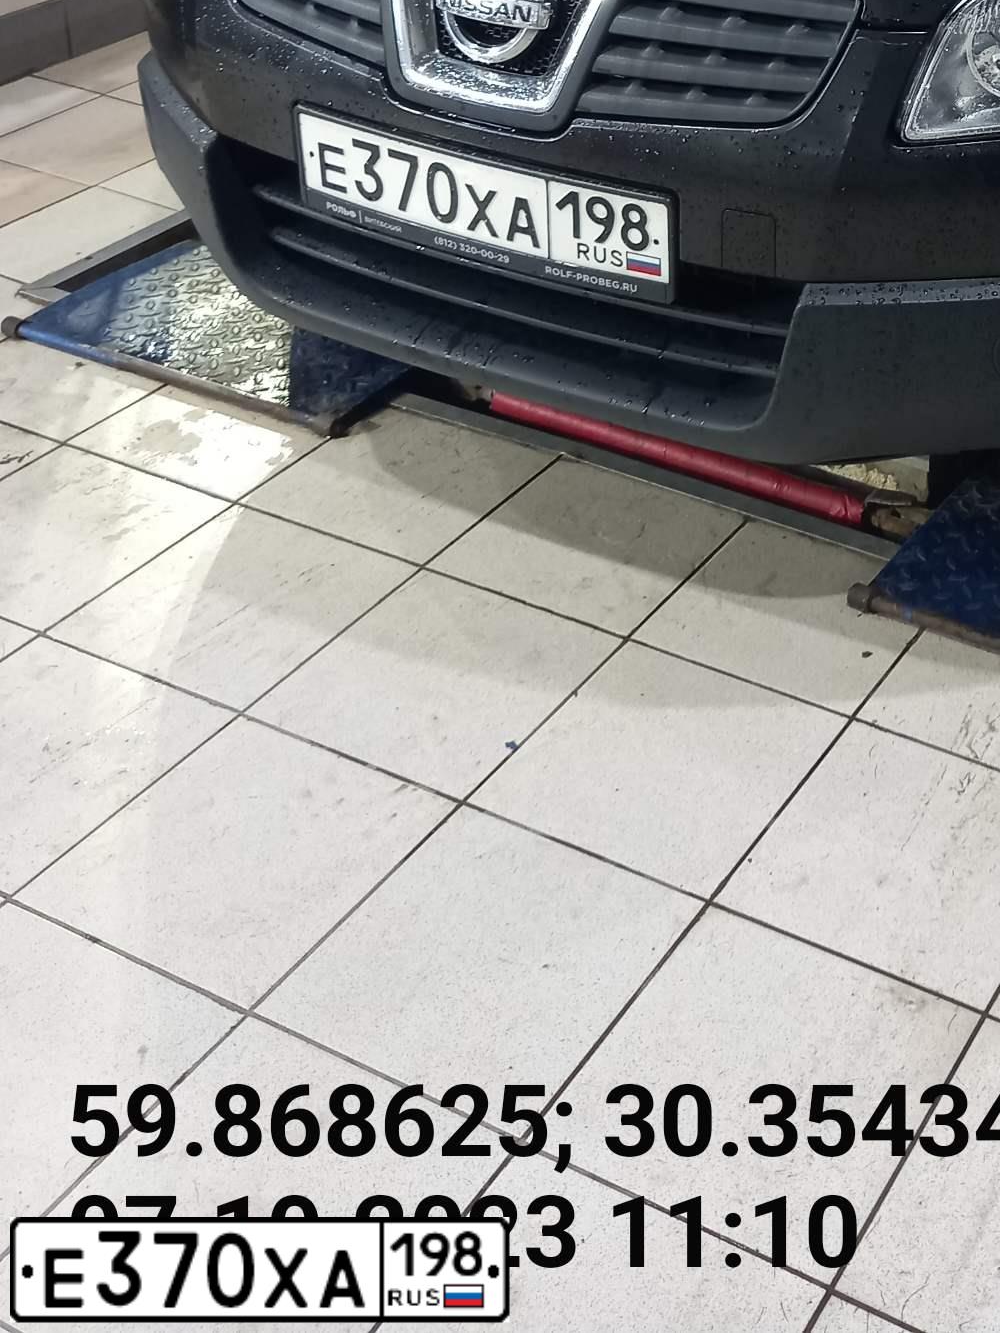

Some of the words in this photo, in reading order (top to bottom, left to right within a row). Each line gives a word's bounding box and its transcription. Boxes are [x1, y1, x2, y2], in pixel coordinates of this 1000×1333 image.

[555, 190, 650, 251] 198
[434, 235, 458, 250] (812)
[459, 242, 511, 264] 320-00-29
[577, 242, 624, 267] RUS
[544, 265, 638, 293] ROLF-PROBEG.RU
